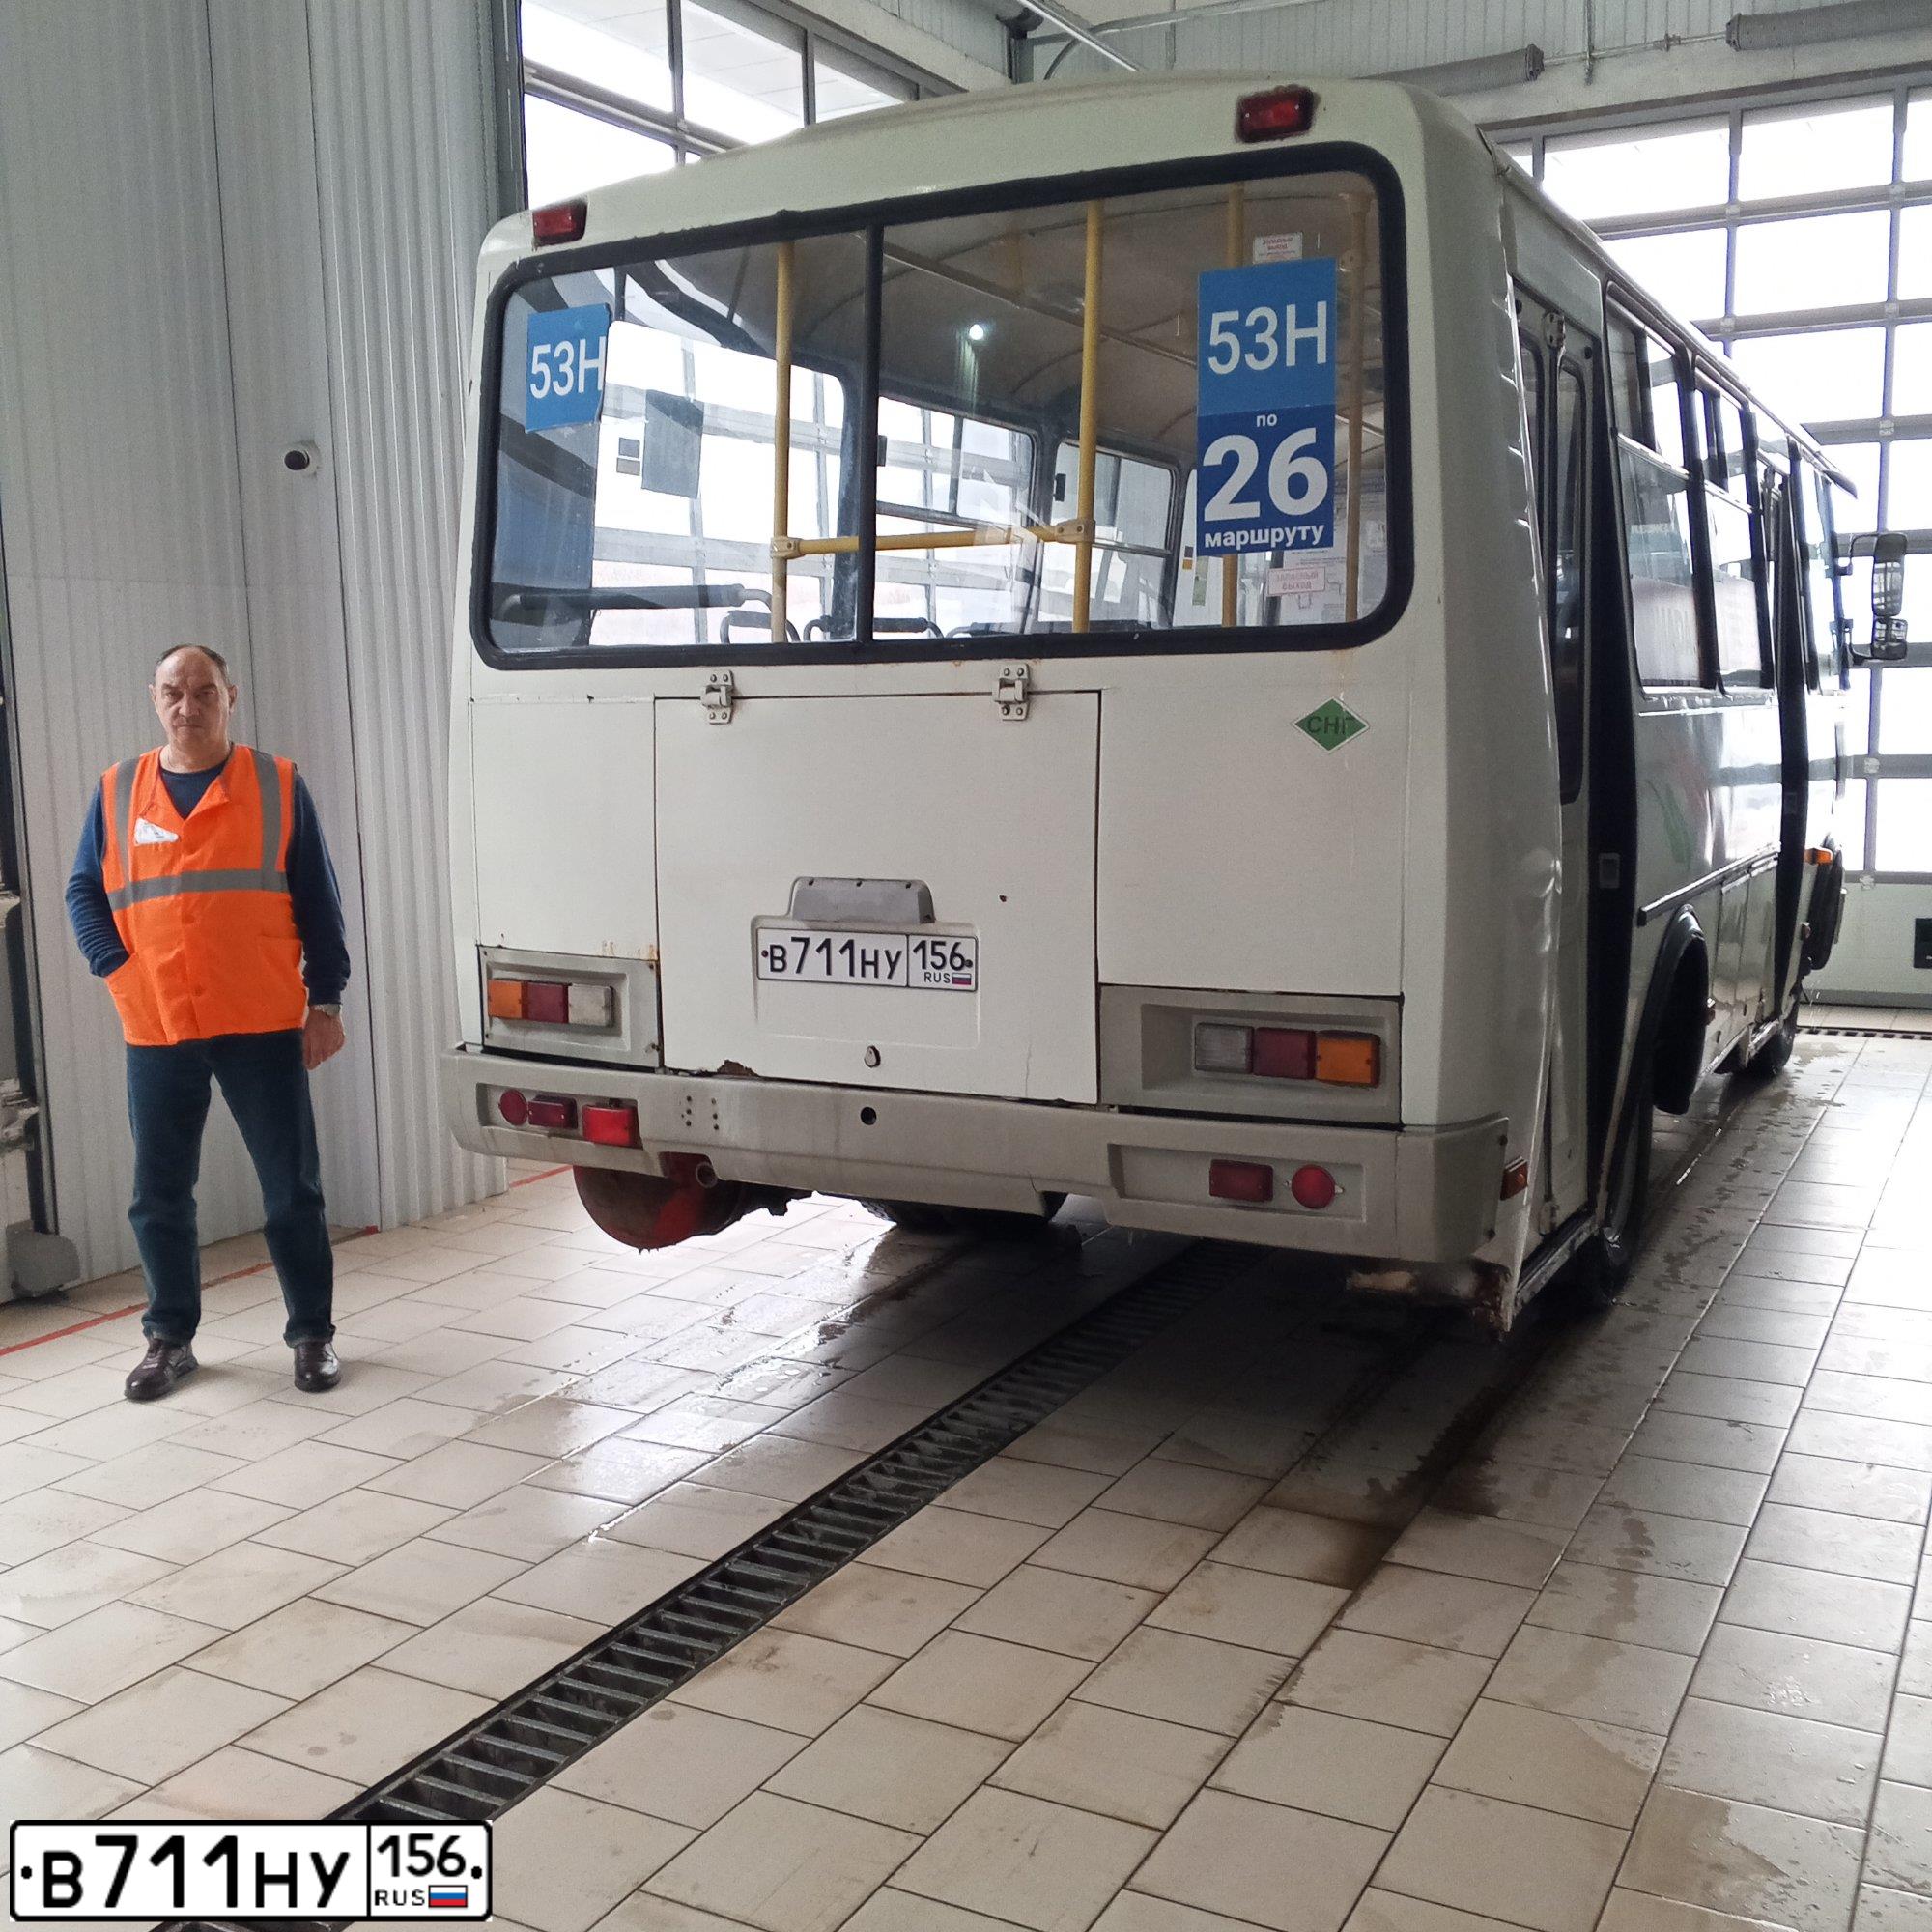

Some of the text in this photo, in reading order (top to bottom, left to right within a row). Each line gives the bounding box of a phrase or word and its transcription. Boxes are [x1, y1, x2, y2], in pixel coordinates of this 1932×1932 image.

[1208, 300, 1327, 374] 53Н
[530, 335, 606, 399] 53Н
[1256, 413, 1278, 428] по
[1203, 427, 1328, 522] 26
[1204, 524, 1325, 550] маршруту
[1308, 716, 1355, 735] СНГ
[769, 936, 966, 980] В711НУ 156
[923, 972, 951, 984] RUS
